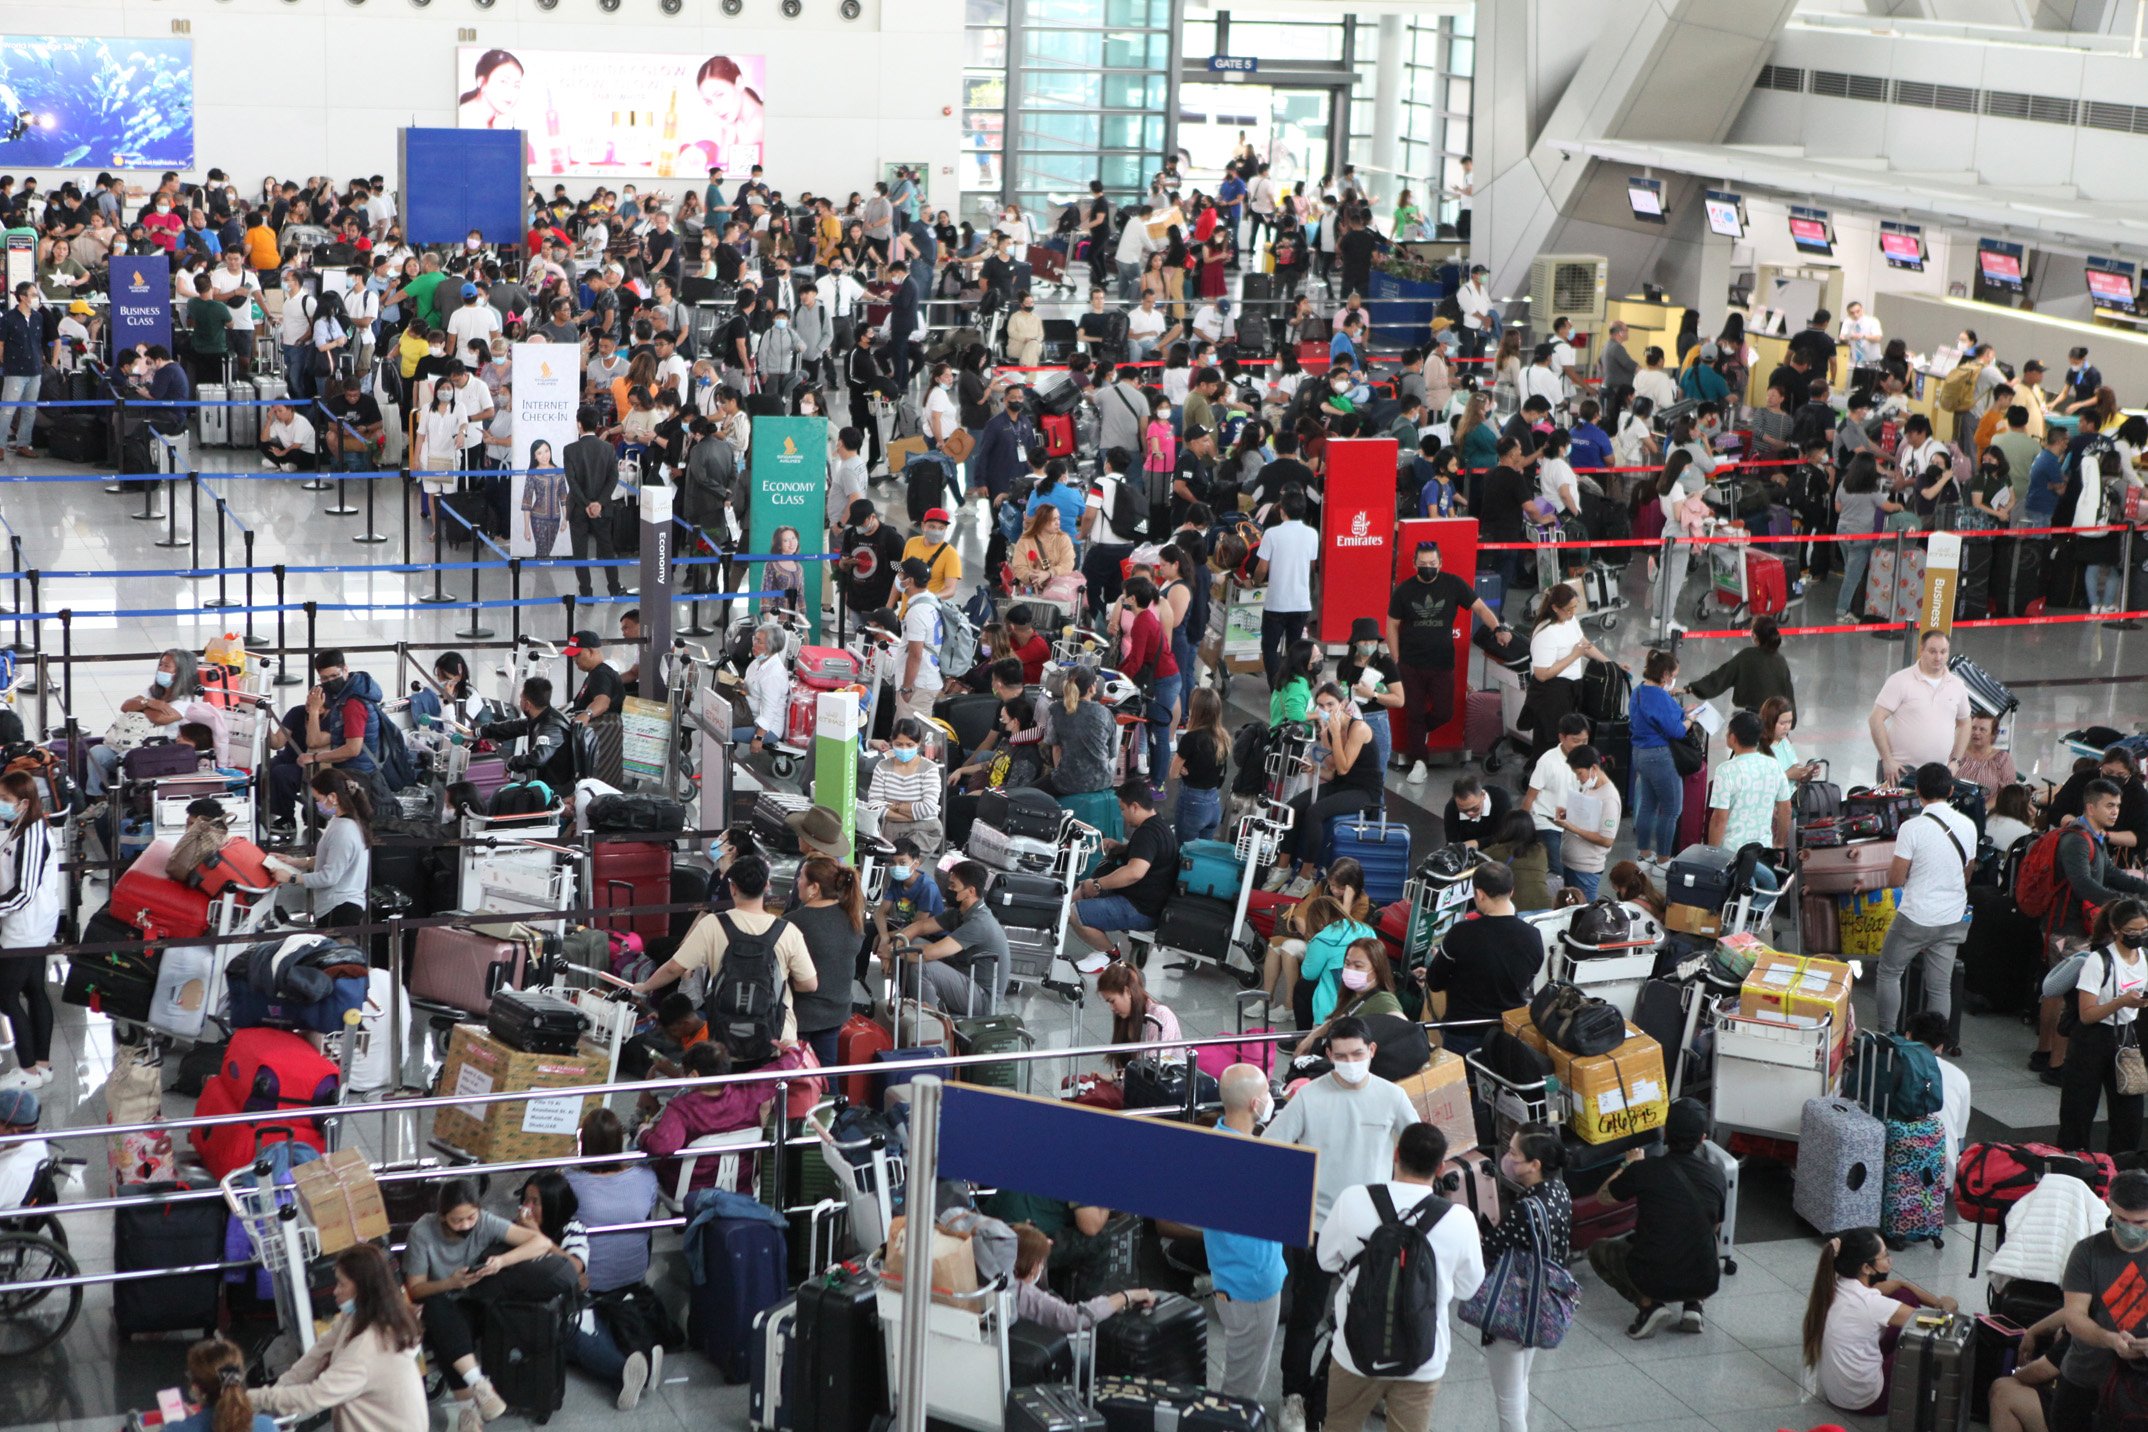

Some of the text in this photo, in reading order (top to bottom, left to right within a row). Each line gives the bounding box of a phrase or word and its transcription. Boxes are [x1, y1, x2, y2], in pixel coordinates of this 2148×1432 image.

[1215, 58, 1252, 69] GATE 5
[120, 306, 160, 316] BUSINESS
[126, 316, 154, 326] CLASS
[522, 399, 569, 410] INTERNET
[521, 411, 568, 422] CHECK-IN
[762, 480, 816, 492] ECONOMY
[771, 493, 805, 505] CLASS
[1336, 535, 1383, 547] Emirates
[657, 532, 666, 585] Economy
[1930, 578, 1945, 627] Business
[1413, 619, 1443, 627] adidas
[818, 716, 845, 728] ETIHAD
